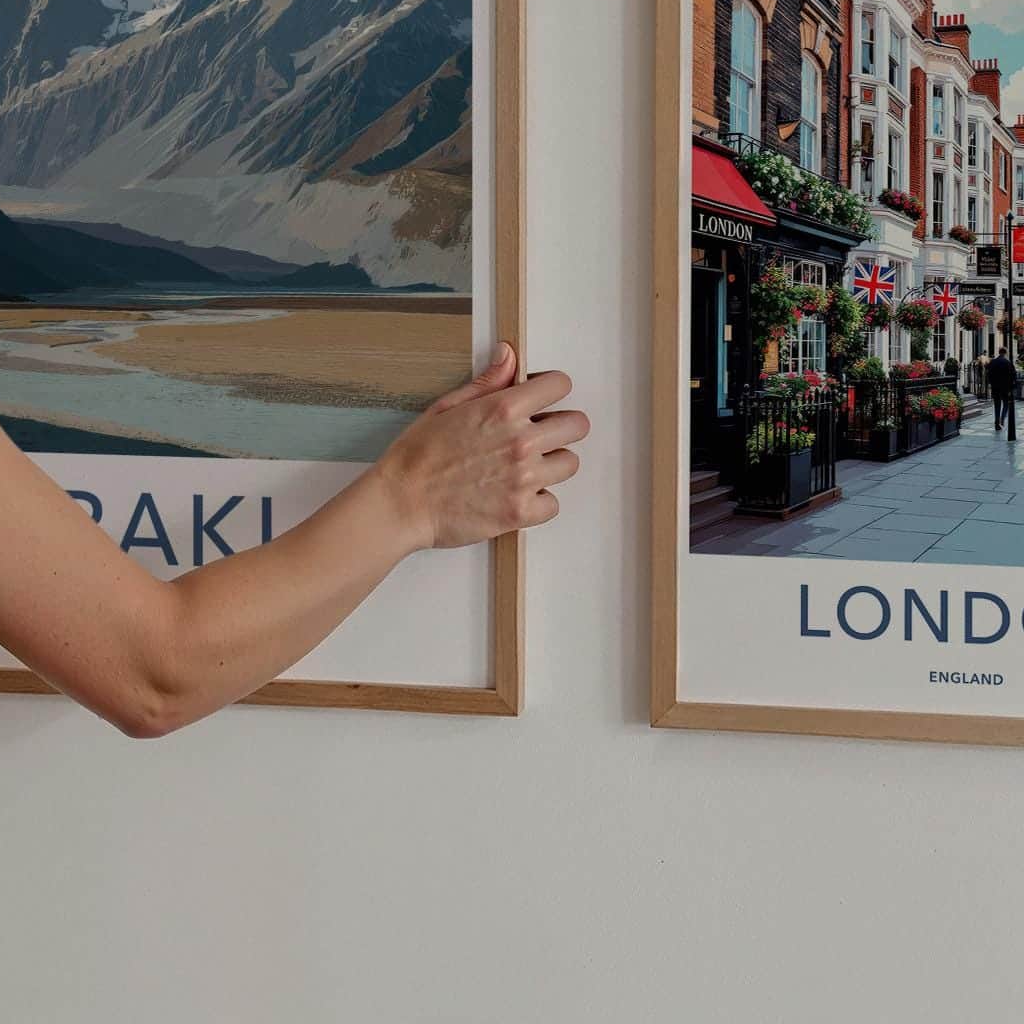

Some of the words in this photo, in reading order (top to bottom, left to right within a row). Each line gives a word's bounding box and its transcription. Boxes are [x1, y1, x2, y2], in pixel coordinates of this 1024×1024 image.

[699, 213, 753, 242] LONDON
[800, 584, 1024, 644] LOND
[929, 670, 1004, 686] ENGLAND
